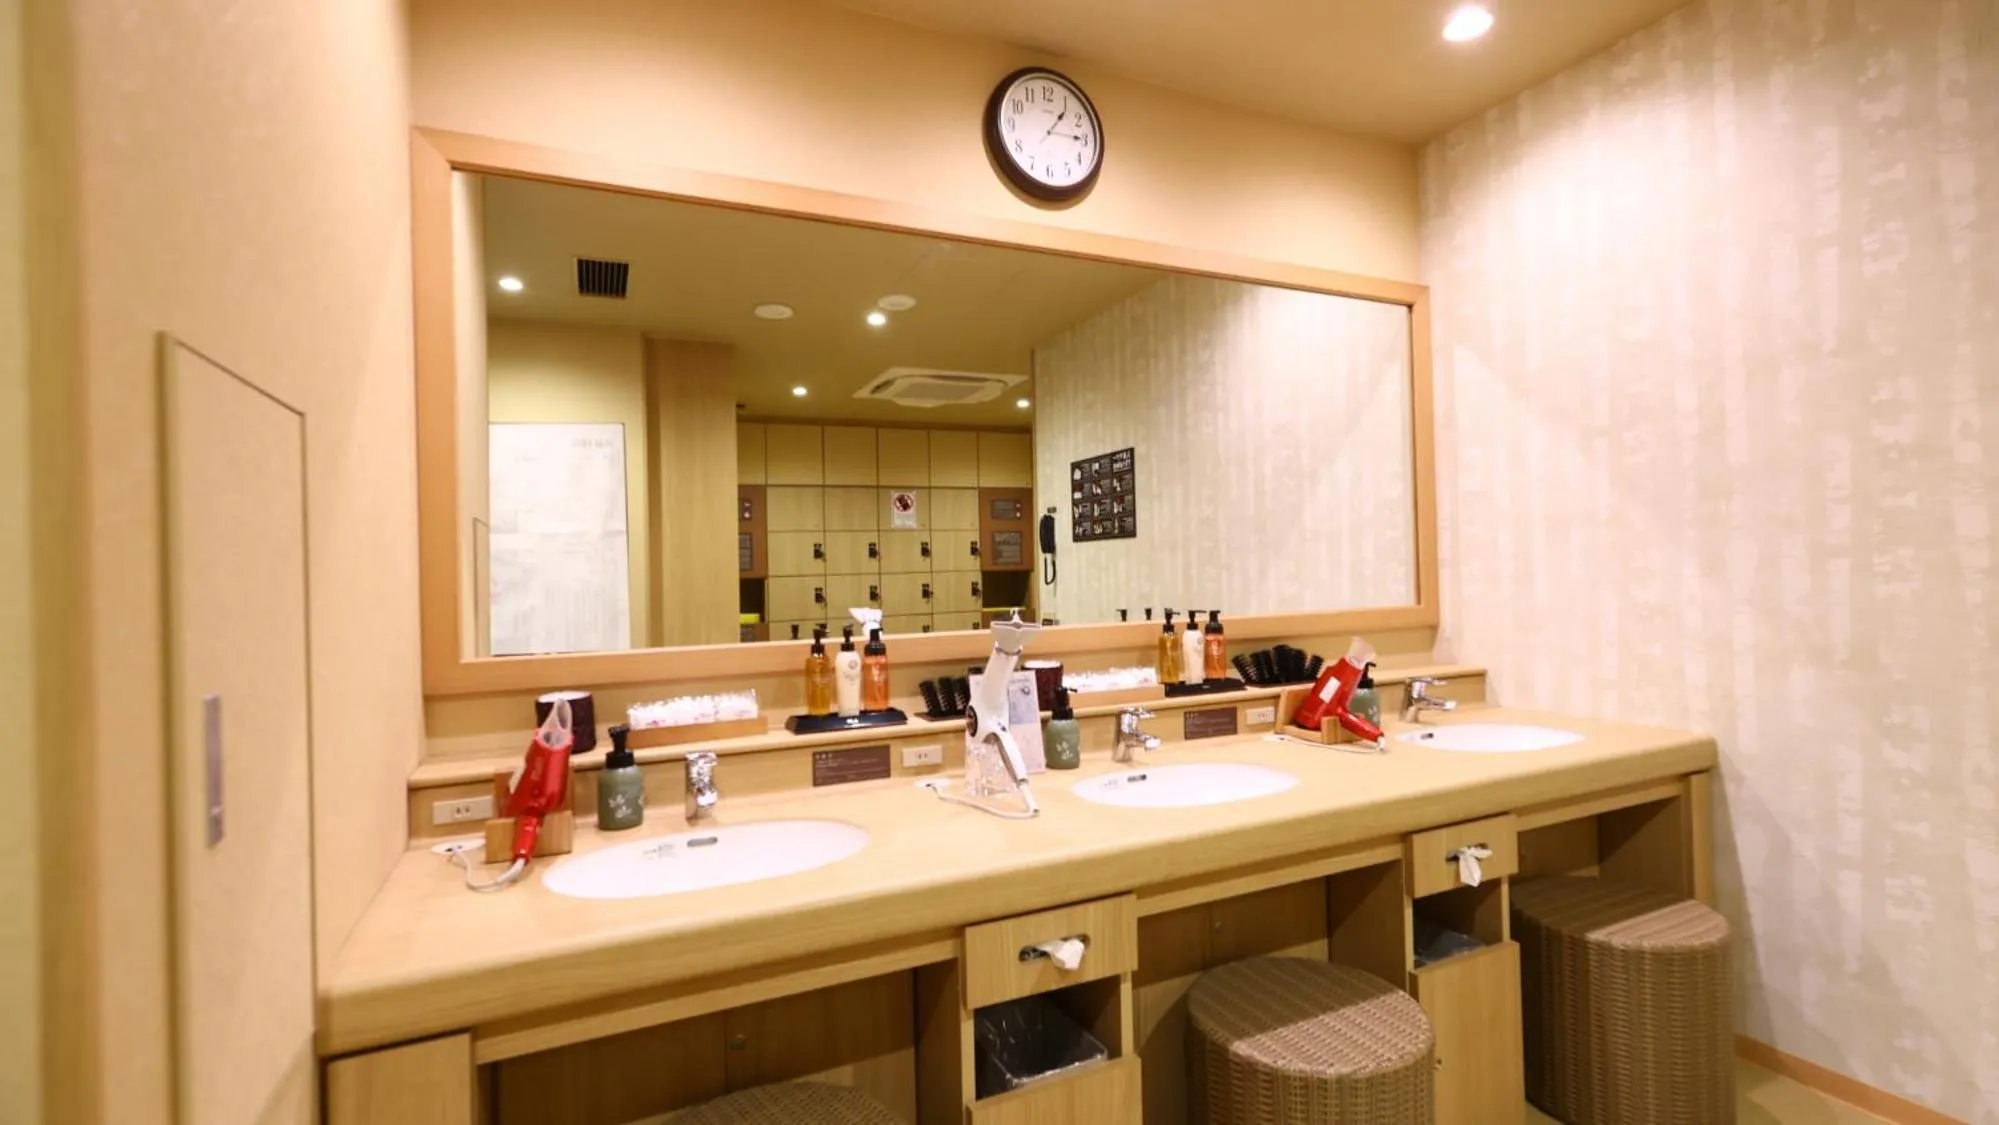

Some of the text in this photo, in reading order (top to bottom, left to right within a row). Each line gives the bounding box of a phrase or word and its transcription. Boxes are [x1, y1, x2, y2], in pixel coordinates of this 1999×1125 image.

[1025, 86, 1035, 104] 11
[1042, 85, 1054, 102] 12
[1012, 98, 1024, 115] 10
[1008, 117, 1015, 132] 9
[1075, 112, 1082, 128] 2
[1014, 139, 1024, 153] 8
[1081, 133, 1088, 147] 3
[1029, 155, 1035, 170] 7
[1064, 161, 1071, 177] 5
[1045, 164, 1054, 178] 6
